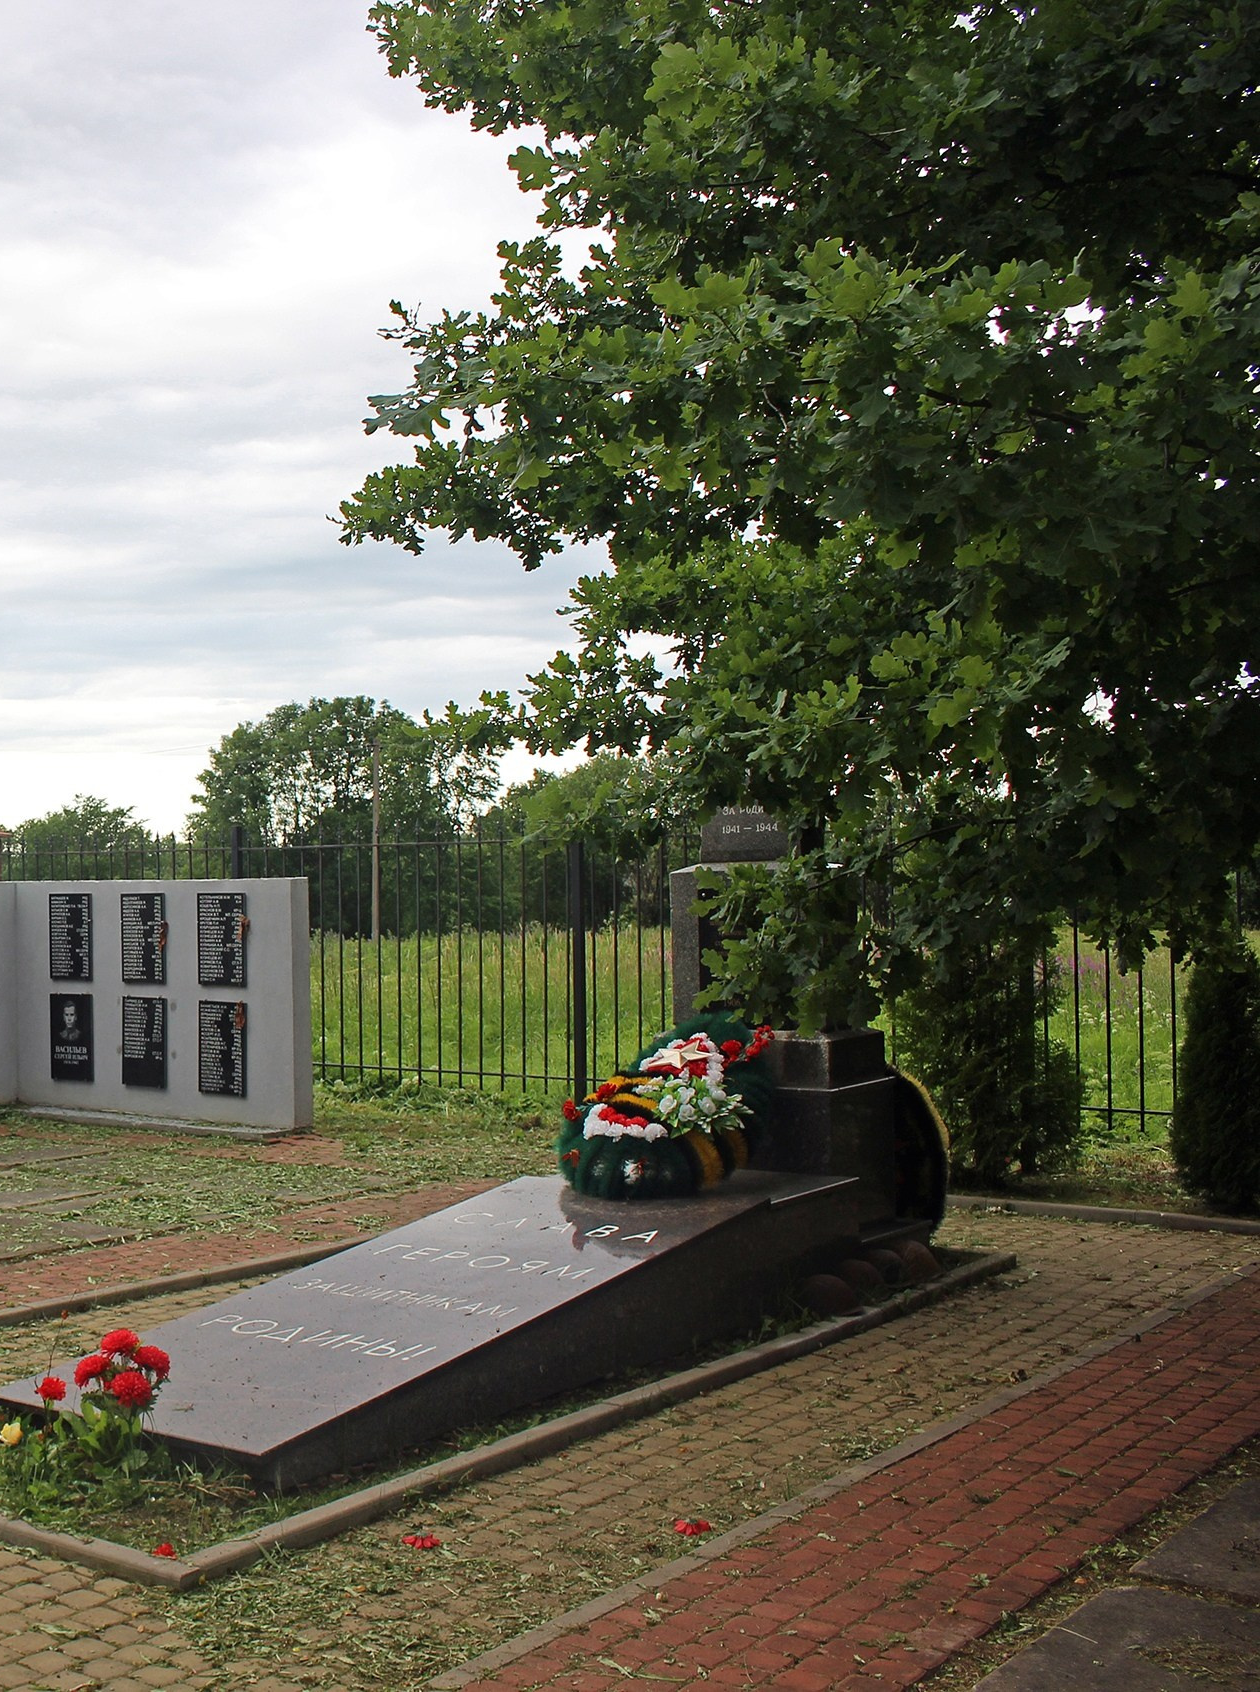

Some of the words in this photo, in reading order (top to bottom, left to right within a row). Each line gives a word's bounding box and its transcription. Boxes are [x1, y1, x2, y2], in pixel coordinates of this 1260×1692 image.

[722, 806, 736, 816] ЗА
[722, 825, 740, 834] 1941
[756, 823, 778, 832] 1944
[55, 1045, 88, 1054] ВАСИЛЬЕВ
[453, 1212, 659, 1243] СЛАВА
[373, 1243, 596, 1280] ГЕРОЯМ
[199, 1314, 437, 1361] РОДИНЫ!
